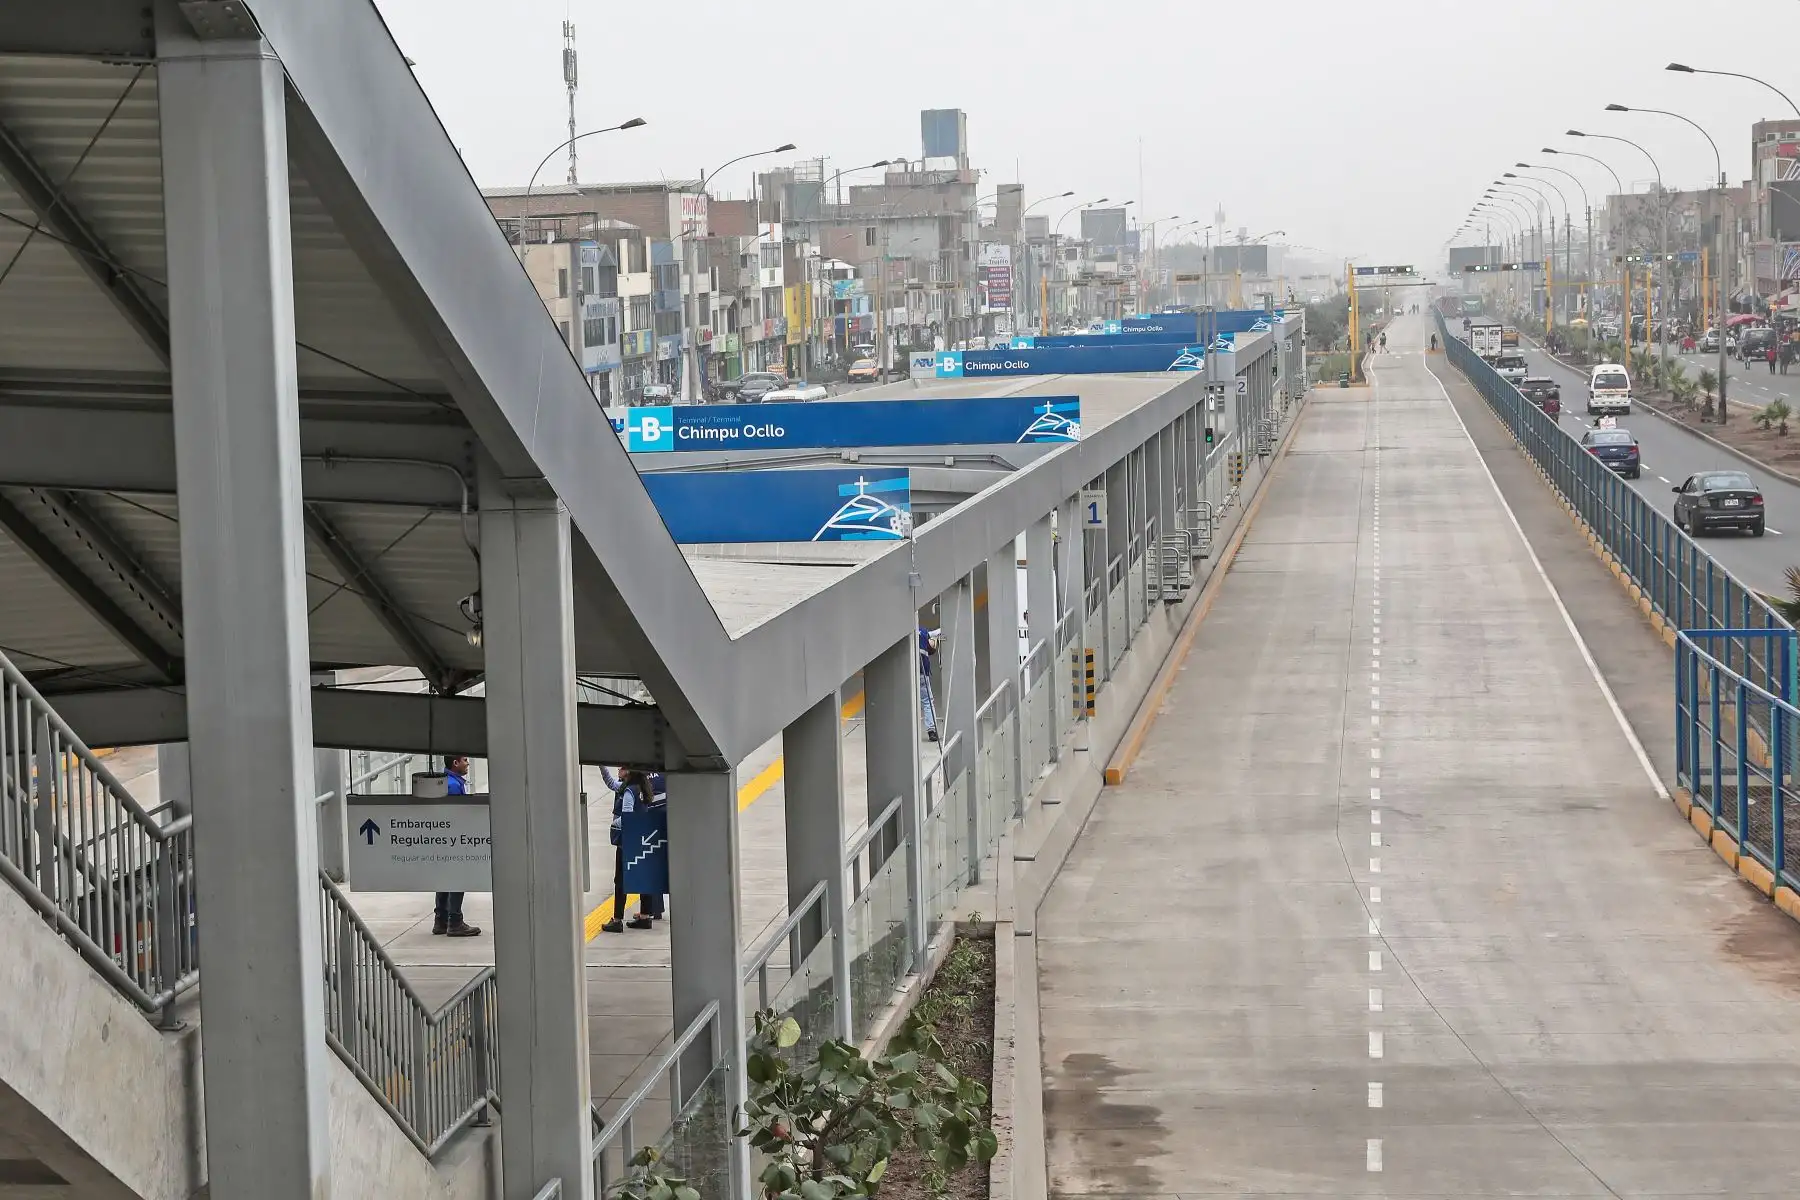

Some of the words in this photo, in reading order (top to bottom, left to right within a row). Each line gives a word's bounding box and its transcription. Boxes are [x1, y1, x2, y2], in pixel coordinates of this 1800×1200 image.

[1110, 324, 1116, 332] B
[1122, 326, 1146, 334] Chimpu
[913, 358, 934, 368] ATU
[944, 357, 955, 372] B
[966, 361, 1002, 371] Chimpu
[1004, 360, 1030, 369] Ocllo
[1238, 382, 1246, 392] 2
[642, 416, 661, 442] B
[678, 426, 739, 441] Chimpu
[743, 424, 785, 438] Ocllo
[1088, 501, 1102, 524] 1
[1018, 630, 1029, 638] LI
[390, 818, 451, 832] Embarques
[390, 834, 448, 847] Regulares
[450, 836, 456, 847] y
[436, 854, 464, 862] Express
